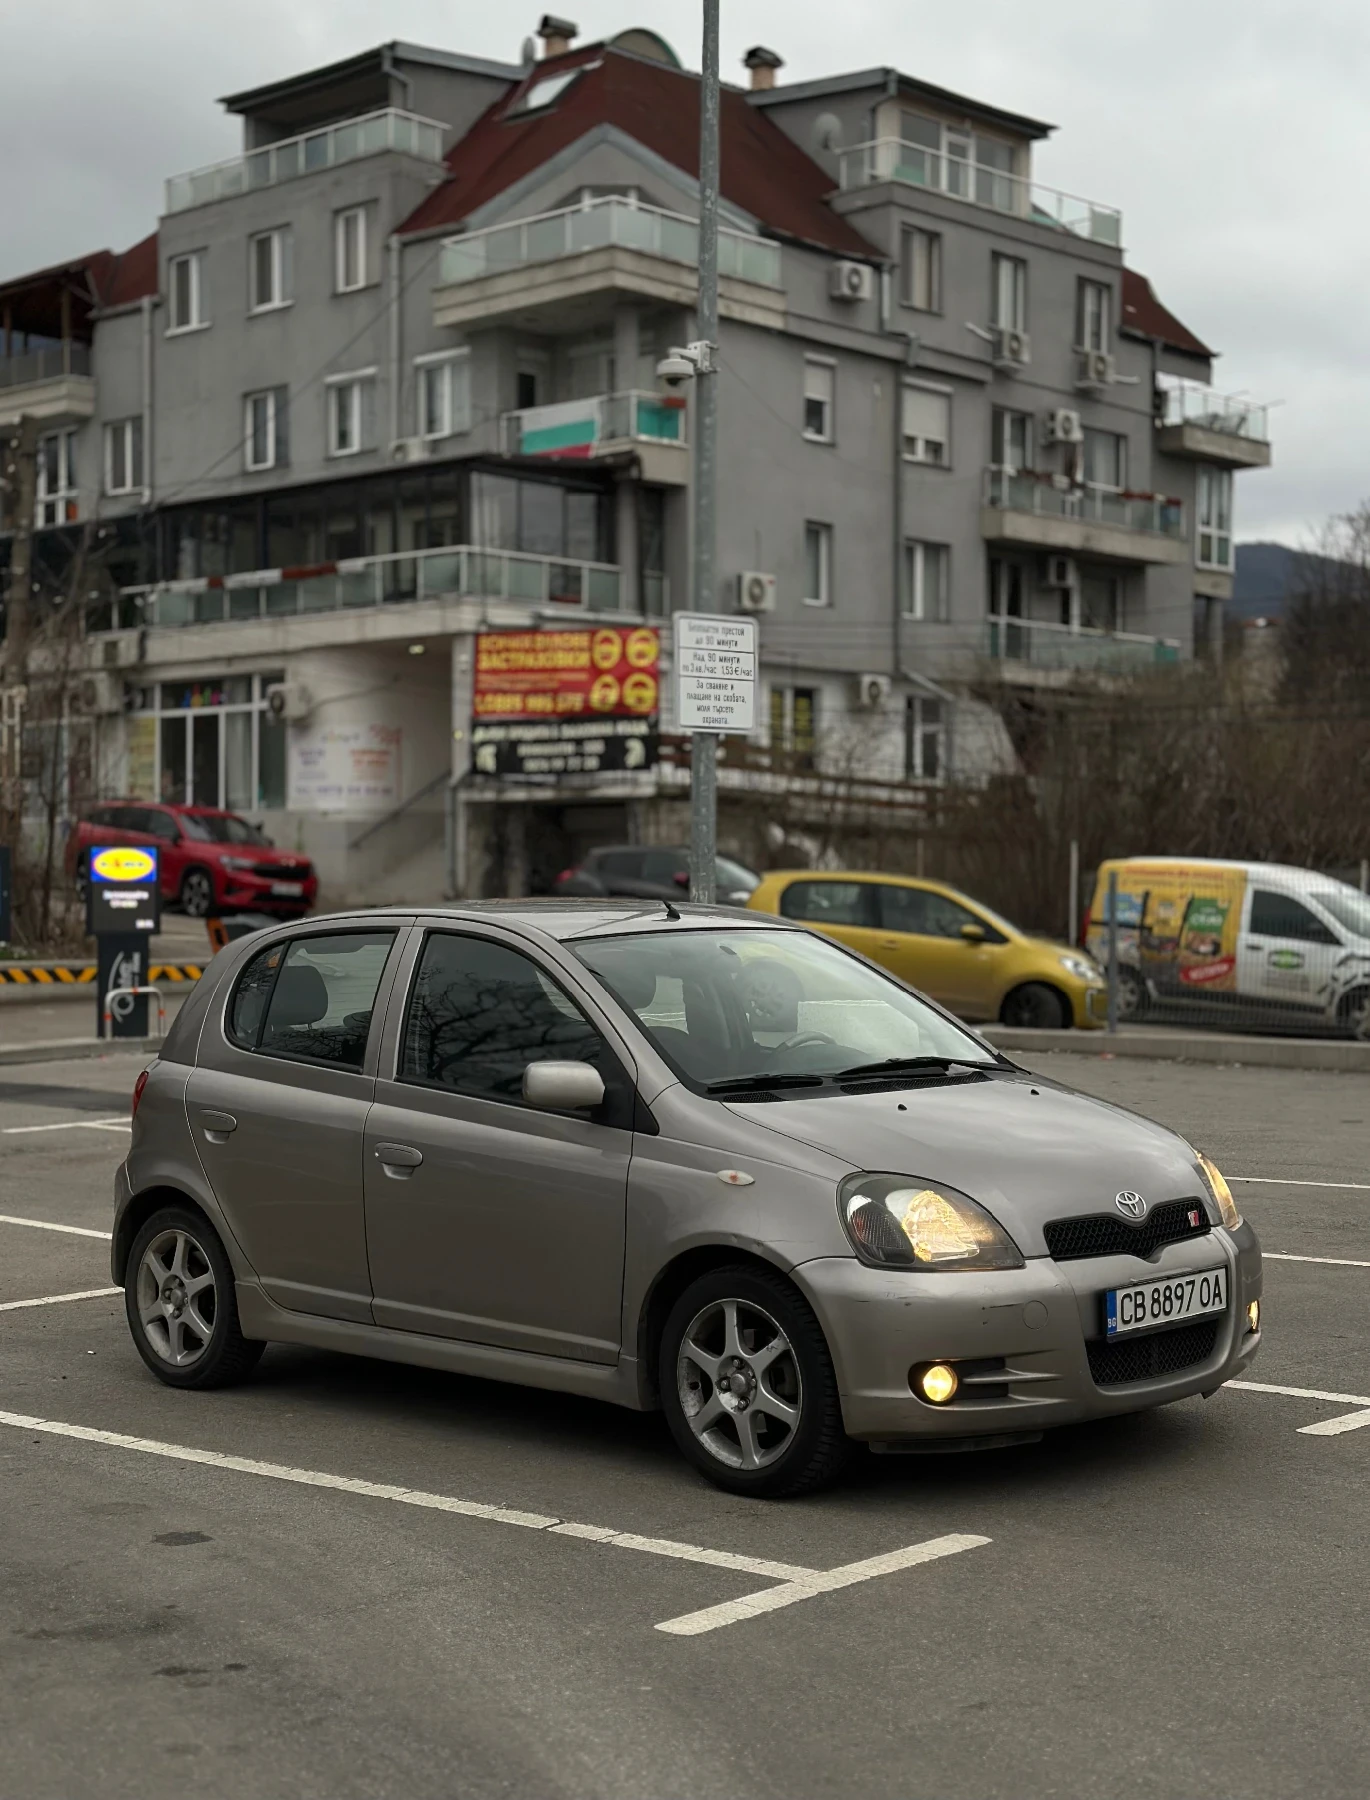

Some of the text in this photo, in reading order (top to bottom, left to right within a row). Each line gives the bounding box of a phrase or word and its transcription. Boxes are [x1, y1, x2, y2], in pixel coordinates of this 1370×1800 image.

[721, 626, 745, 637] престой
[705, 635, 715, 646] 90
[716, 638, 738, 648] минути
[693, 651, 741, 665] Над 90 минути
[696, 679, 704, 689] За
[706, 681, 729, 691] сваляне
[686, 692, 747, 704] плащане на скобата,
[696, 704, 735, 715] моля търсете
[1120, 1274, 1223, 1325] CB 8897 OA
[1107, 1317, 1117, 1328] BG
